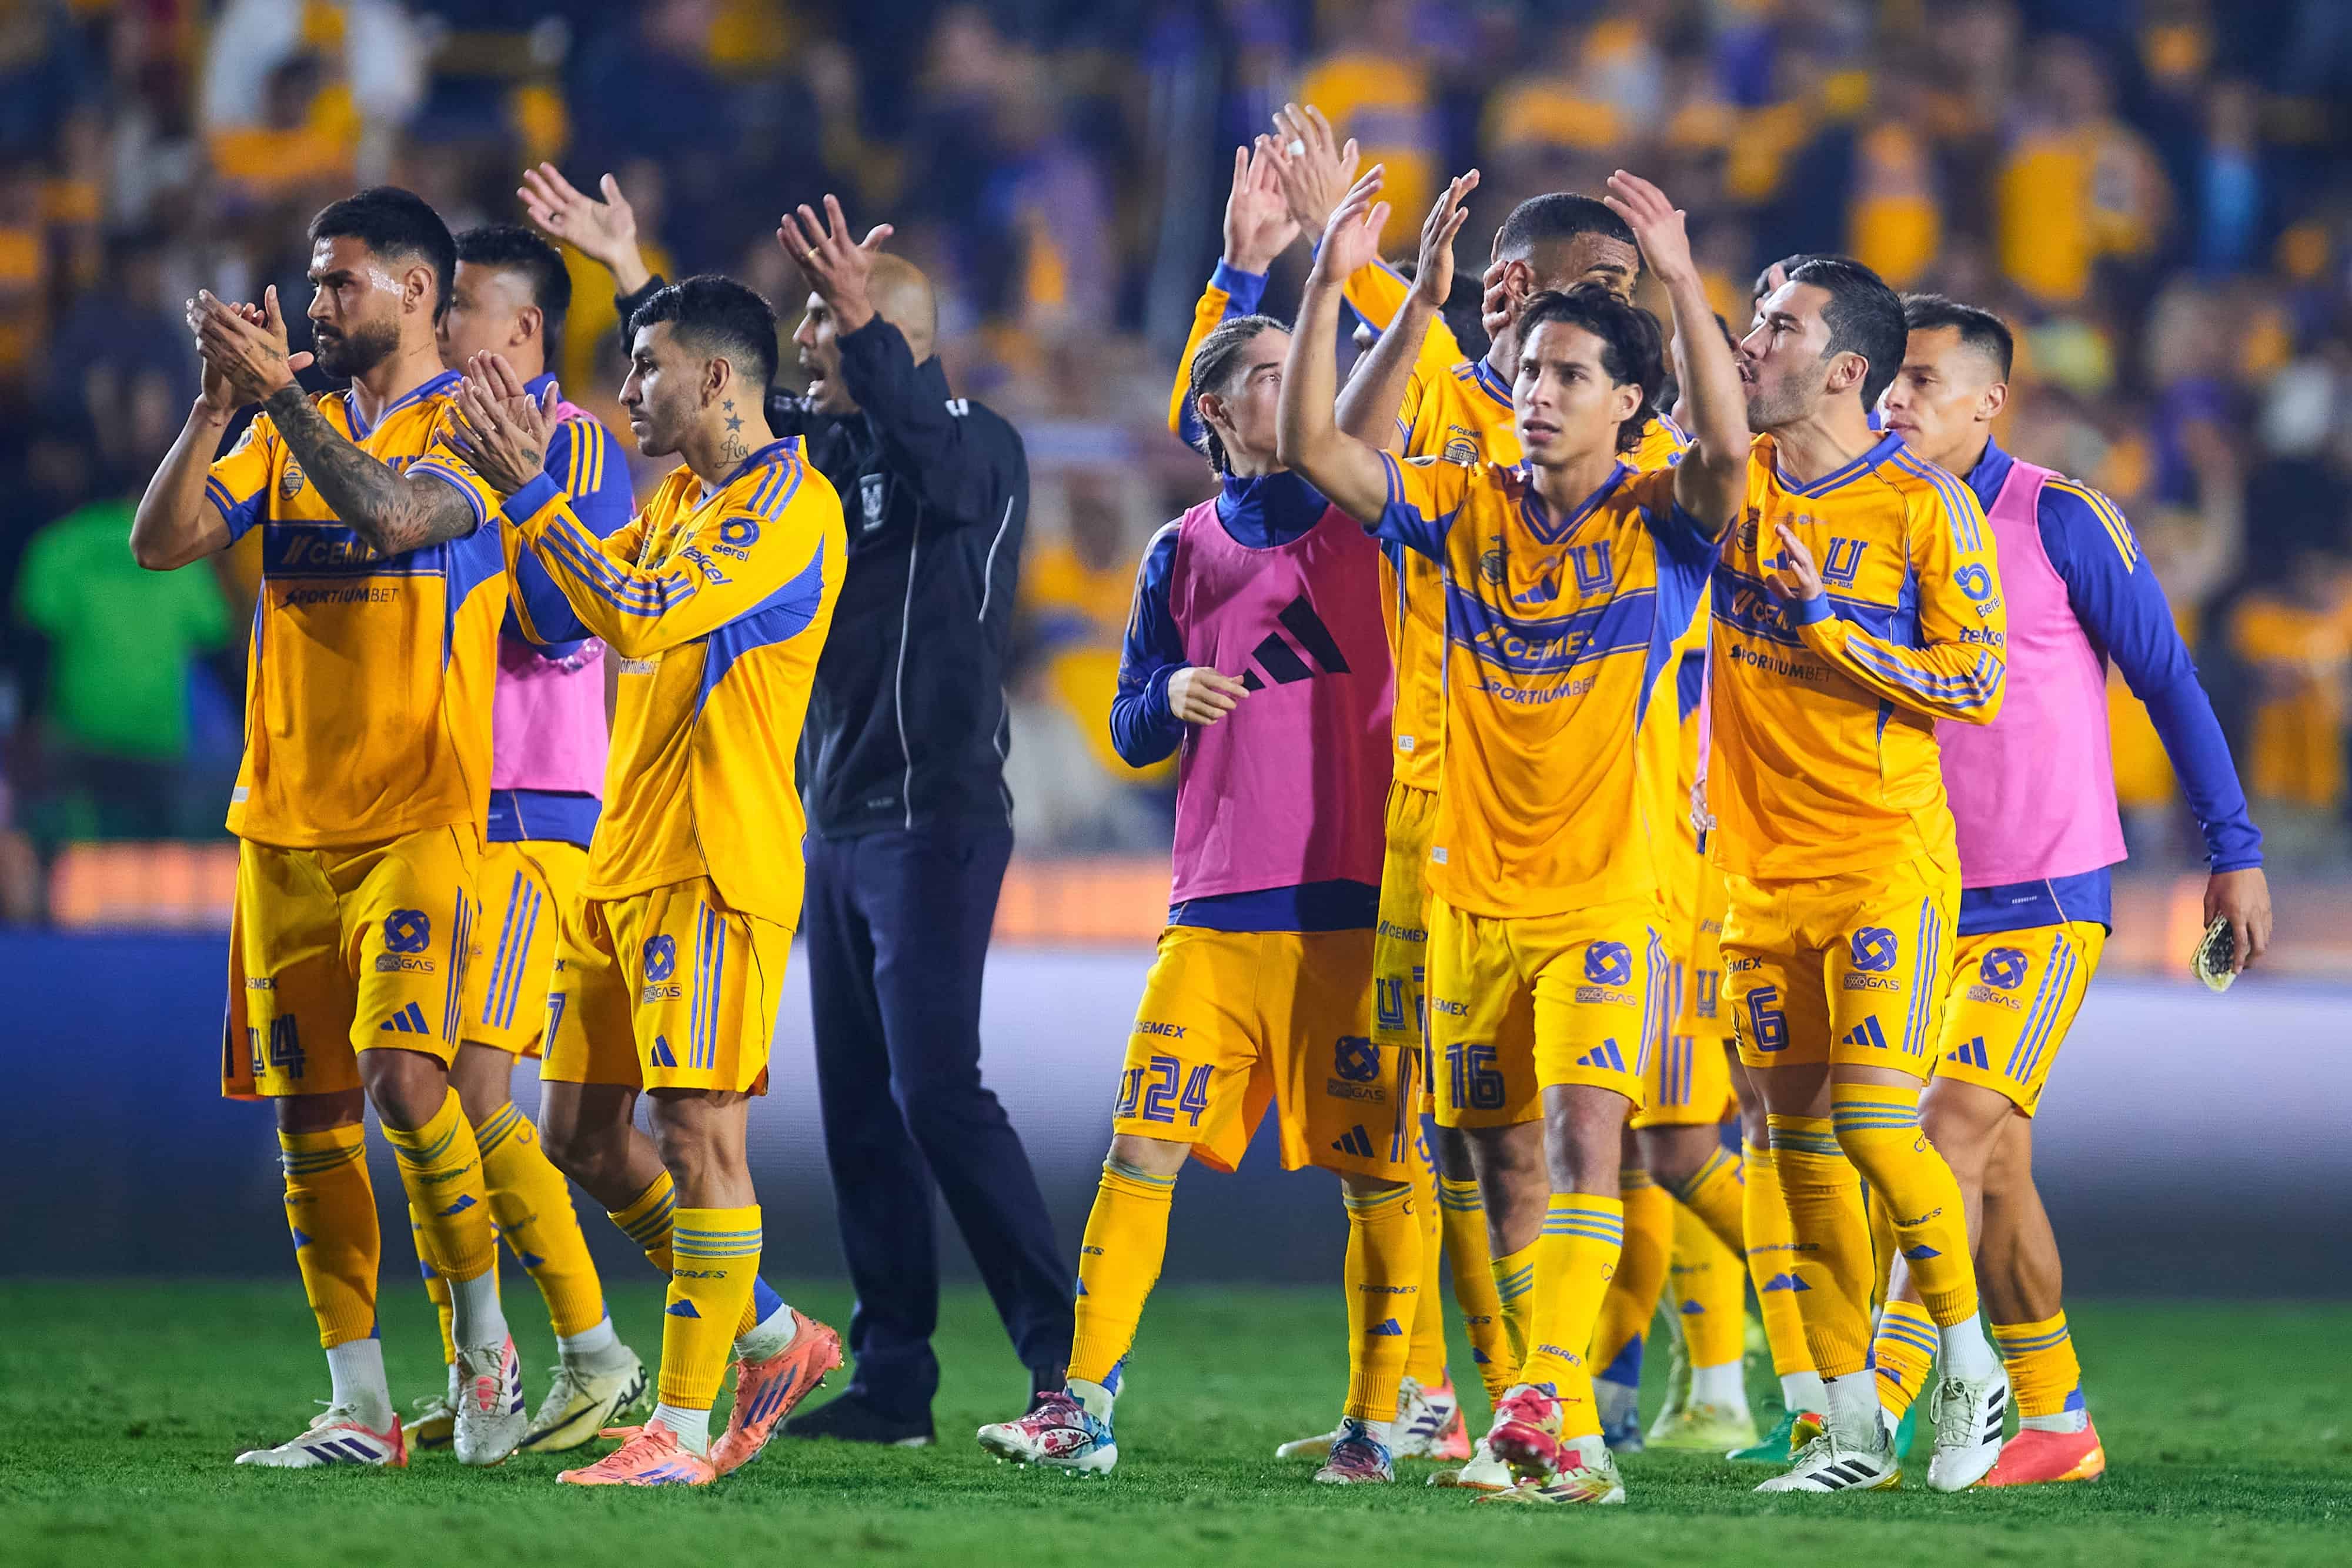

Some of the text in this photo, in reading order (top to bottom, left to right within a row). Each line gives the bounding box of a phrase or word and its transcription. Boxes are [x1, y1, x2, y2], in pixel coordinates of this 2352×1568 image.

[712, 544, 751, 562] Berel
[1567, 540, 1613, 591] U
[1823, 536, 1868, 581] U
[1504, 631, 1595, 661] CEME
[1746, 985, 1790, 1052] 6
[1445, 1043, 1505, 1110] 16
